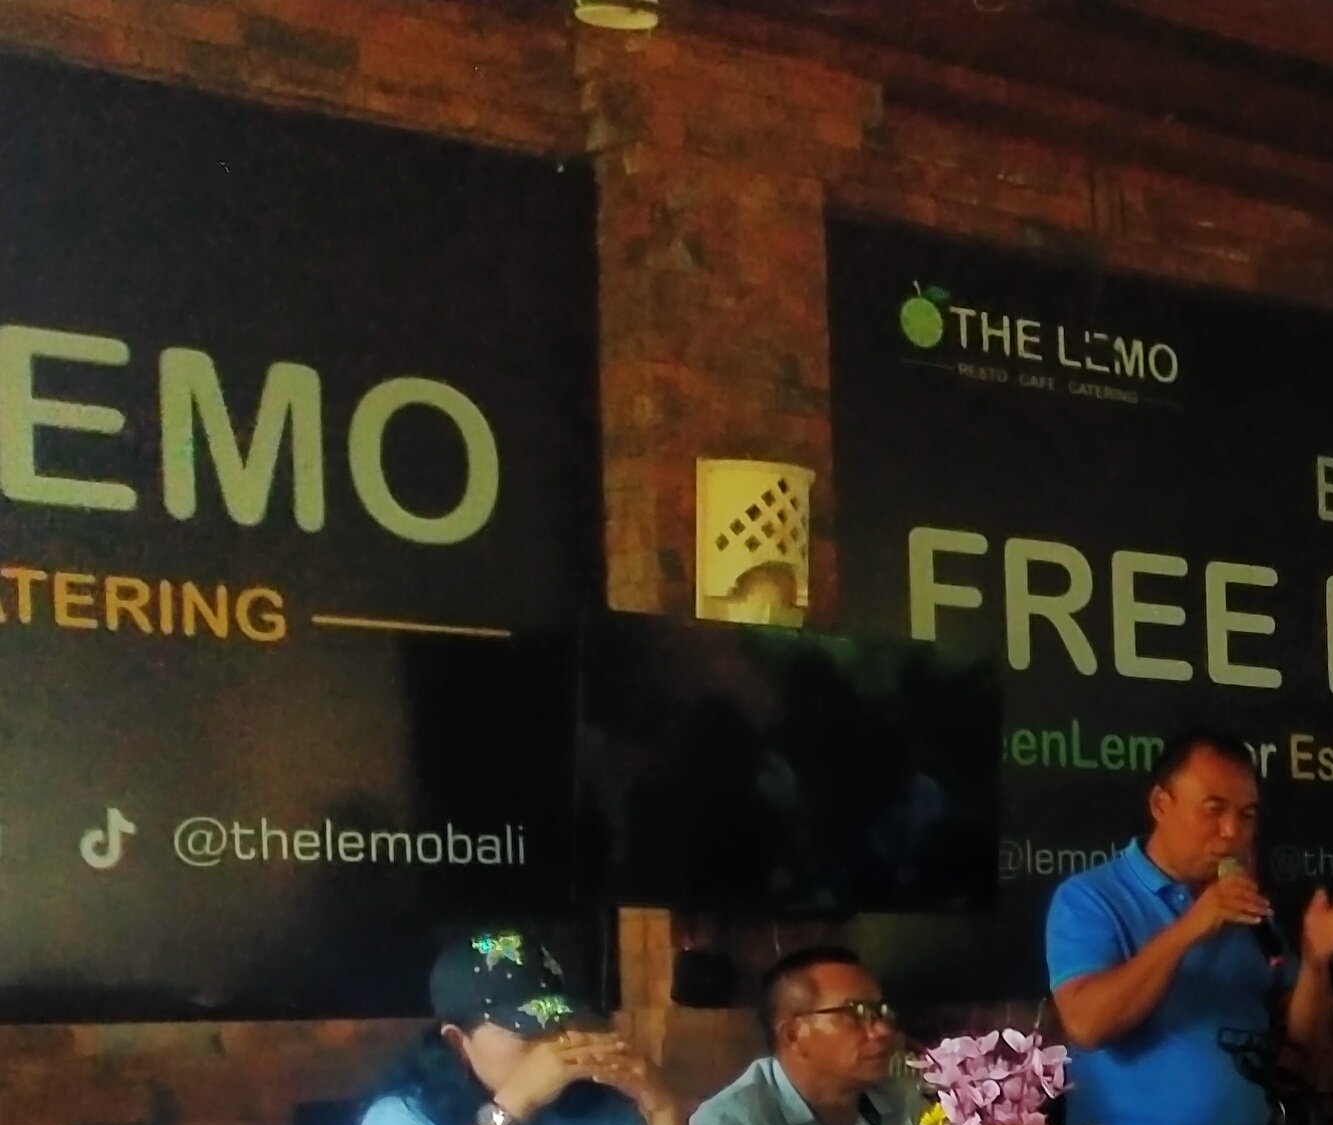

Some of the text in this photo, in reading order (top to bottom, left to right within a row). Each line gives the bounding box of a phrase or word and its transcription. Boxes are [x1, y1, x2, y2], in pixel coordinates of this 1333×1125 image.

[950, 306, 1043, 361] THE
[0, 567, 288, 641] TERING
[908, 526, 1283, 689] FREE
[1002, 718, 1166, 772] enLem
[173, 816, 526, 867] @thelemobali
